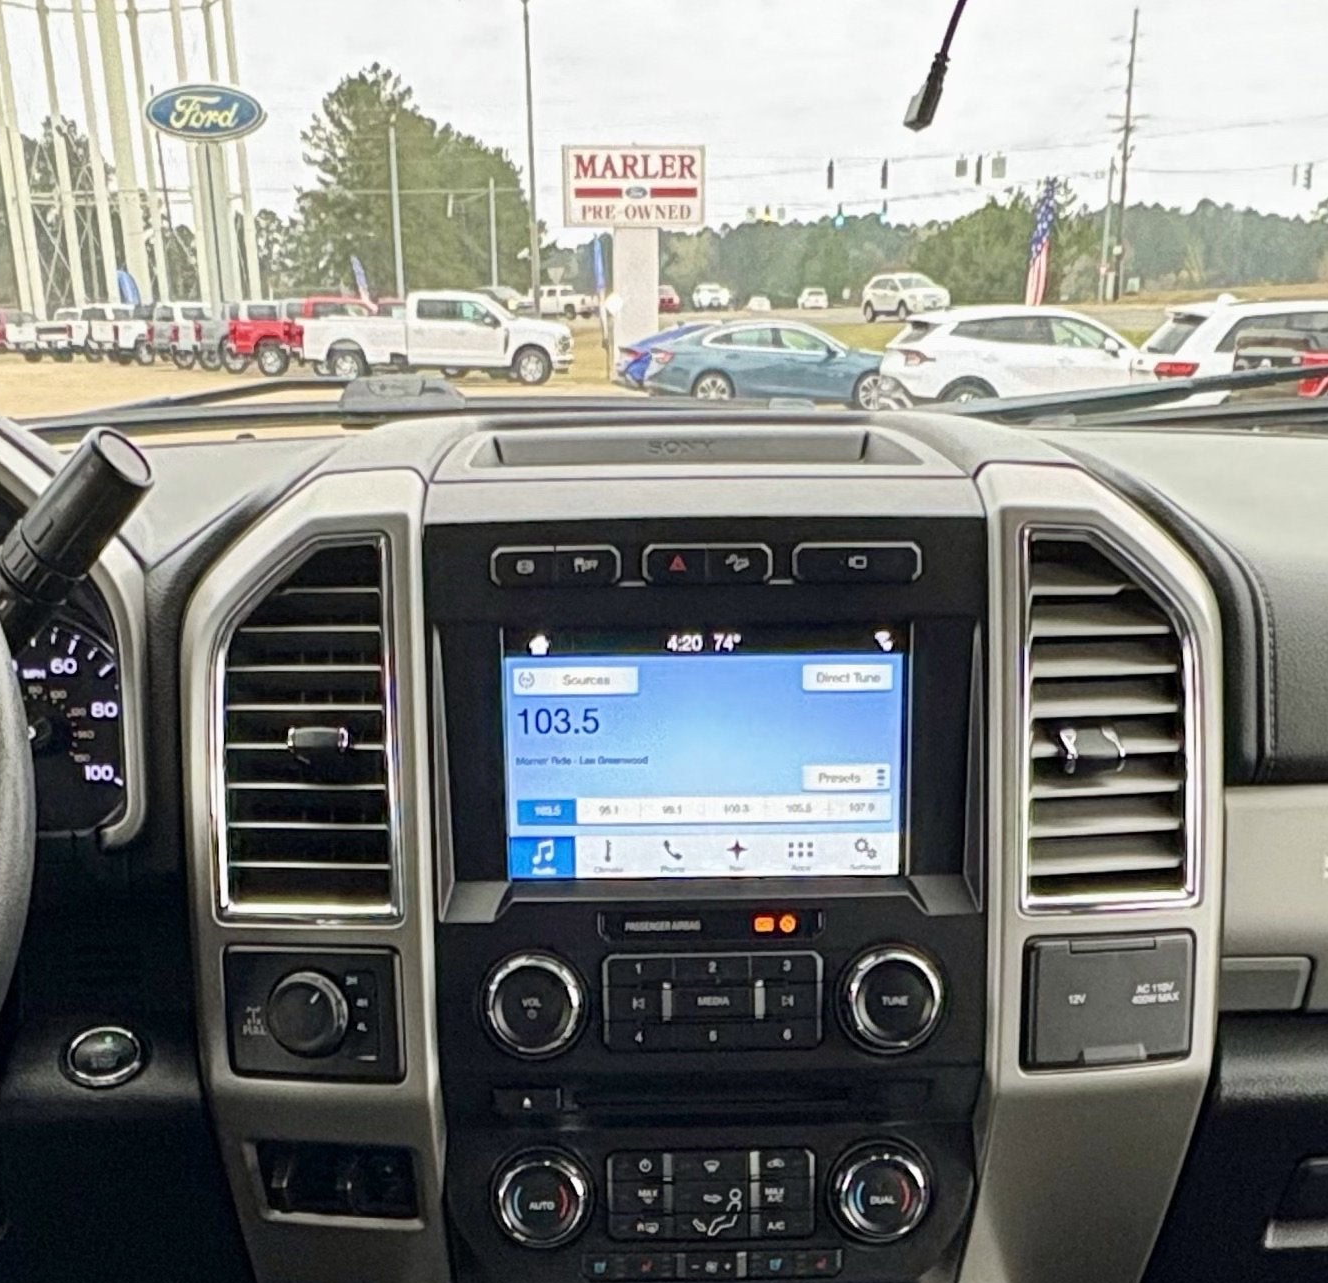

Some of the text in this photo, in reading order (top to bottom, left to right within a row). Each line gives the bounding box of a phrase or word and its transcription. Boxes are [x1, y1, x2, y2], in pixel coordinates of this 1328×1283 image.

[170, 95, 239, 129] Ford
[574, 154, 697, 180] MARLER
[581, 204, 691, 220] PRE-OWNED
[666, 634, 704, 652] 4:20
[50, 658, 78, 675] 60
[562, 674, 611, 686] Sources
[816, 672, 881, 684] Direct Tune
[91, 702, 118, 718] 80
[517, 708, 600, 735] 103.5
[84, 765, 115, 781] 100
[818, 772, 862, 784] Presets
[625, 921, 671, 931] PASSENGER
[522, 997, 542, 1008] VOL
[697, 997, 731, 1007] MEDIA
[881, 995, 909, 1006] TUNE
[528, 1201, 555, 1211] AUTO
[869, 1195, 895, 1206] DUAL
